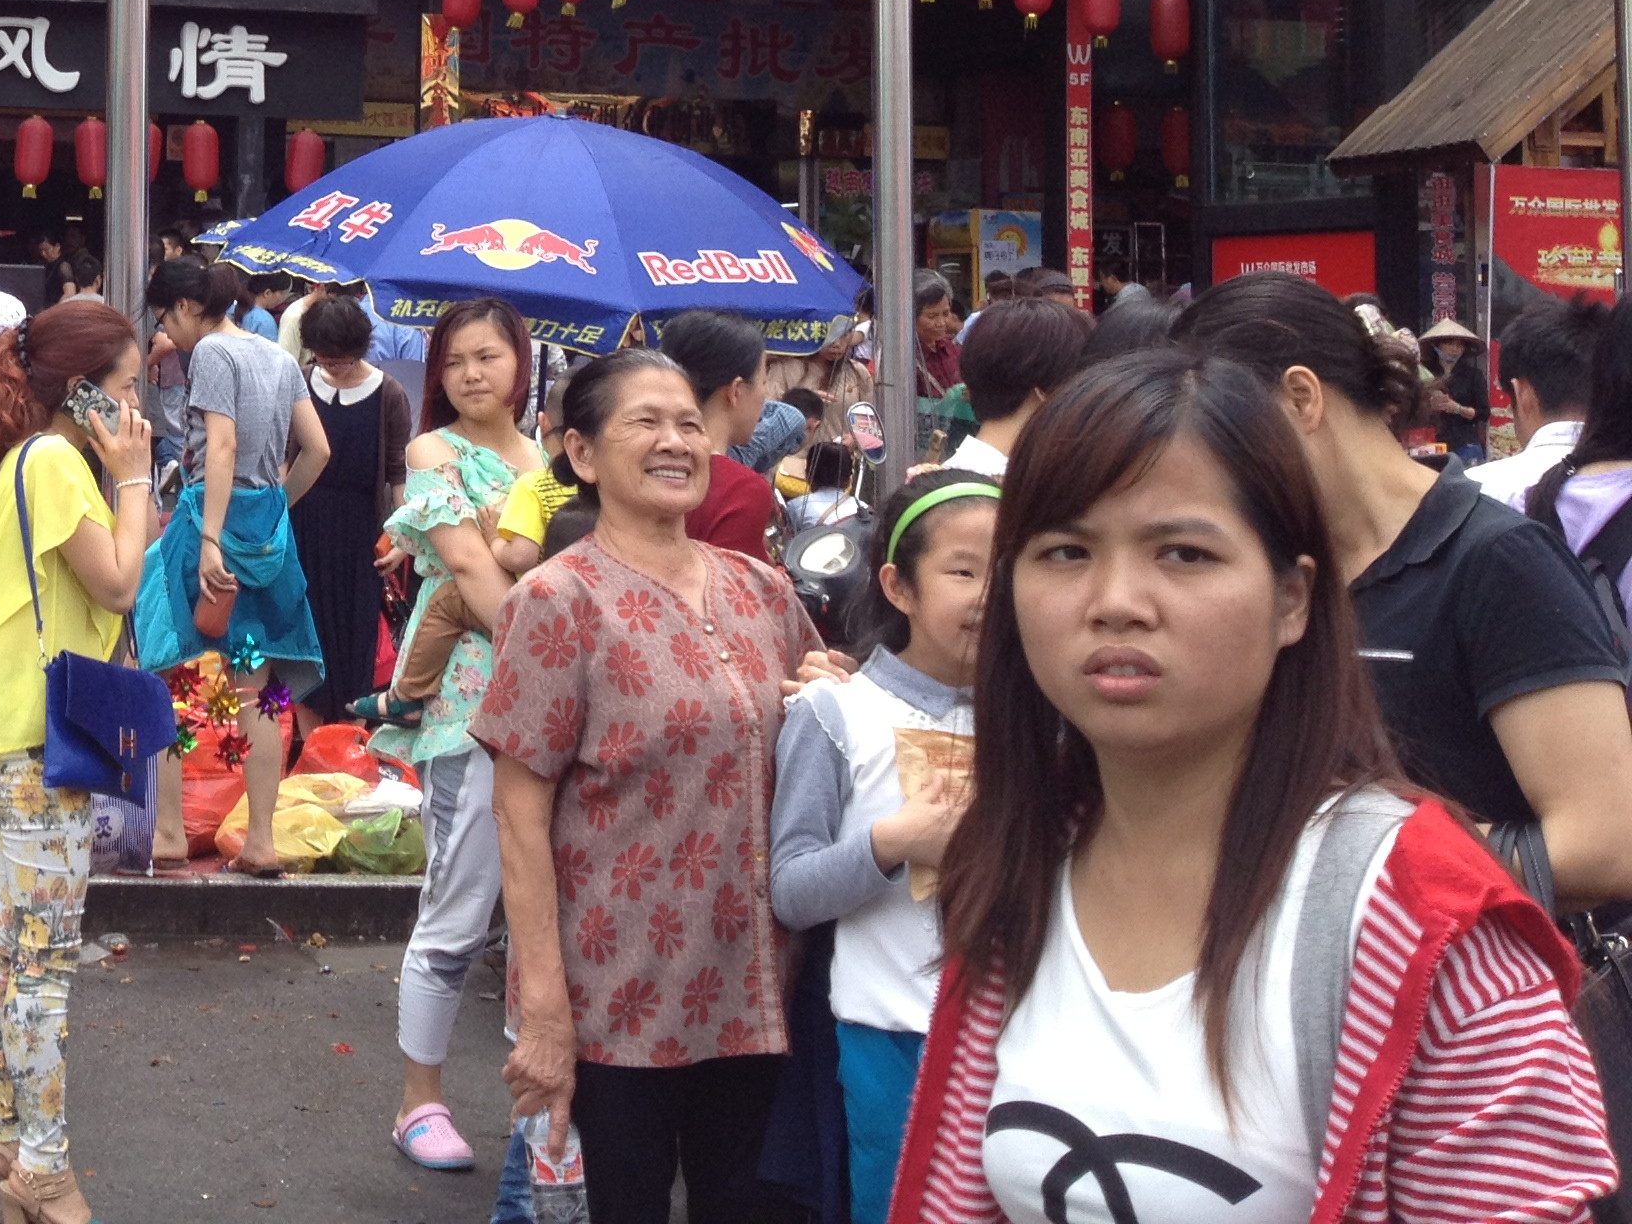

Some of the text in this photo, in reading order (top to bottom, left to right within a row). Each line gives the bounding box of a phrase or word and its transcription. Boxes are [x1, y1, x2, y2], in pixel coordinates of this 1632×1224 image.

[1069, 72, 1091, 86] 5F
[288, 189, 394, 244] 红牛
[524, 316, 606, 345] 力十足
